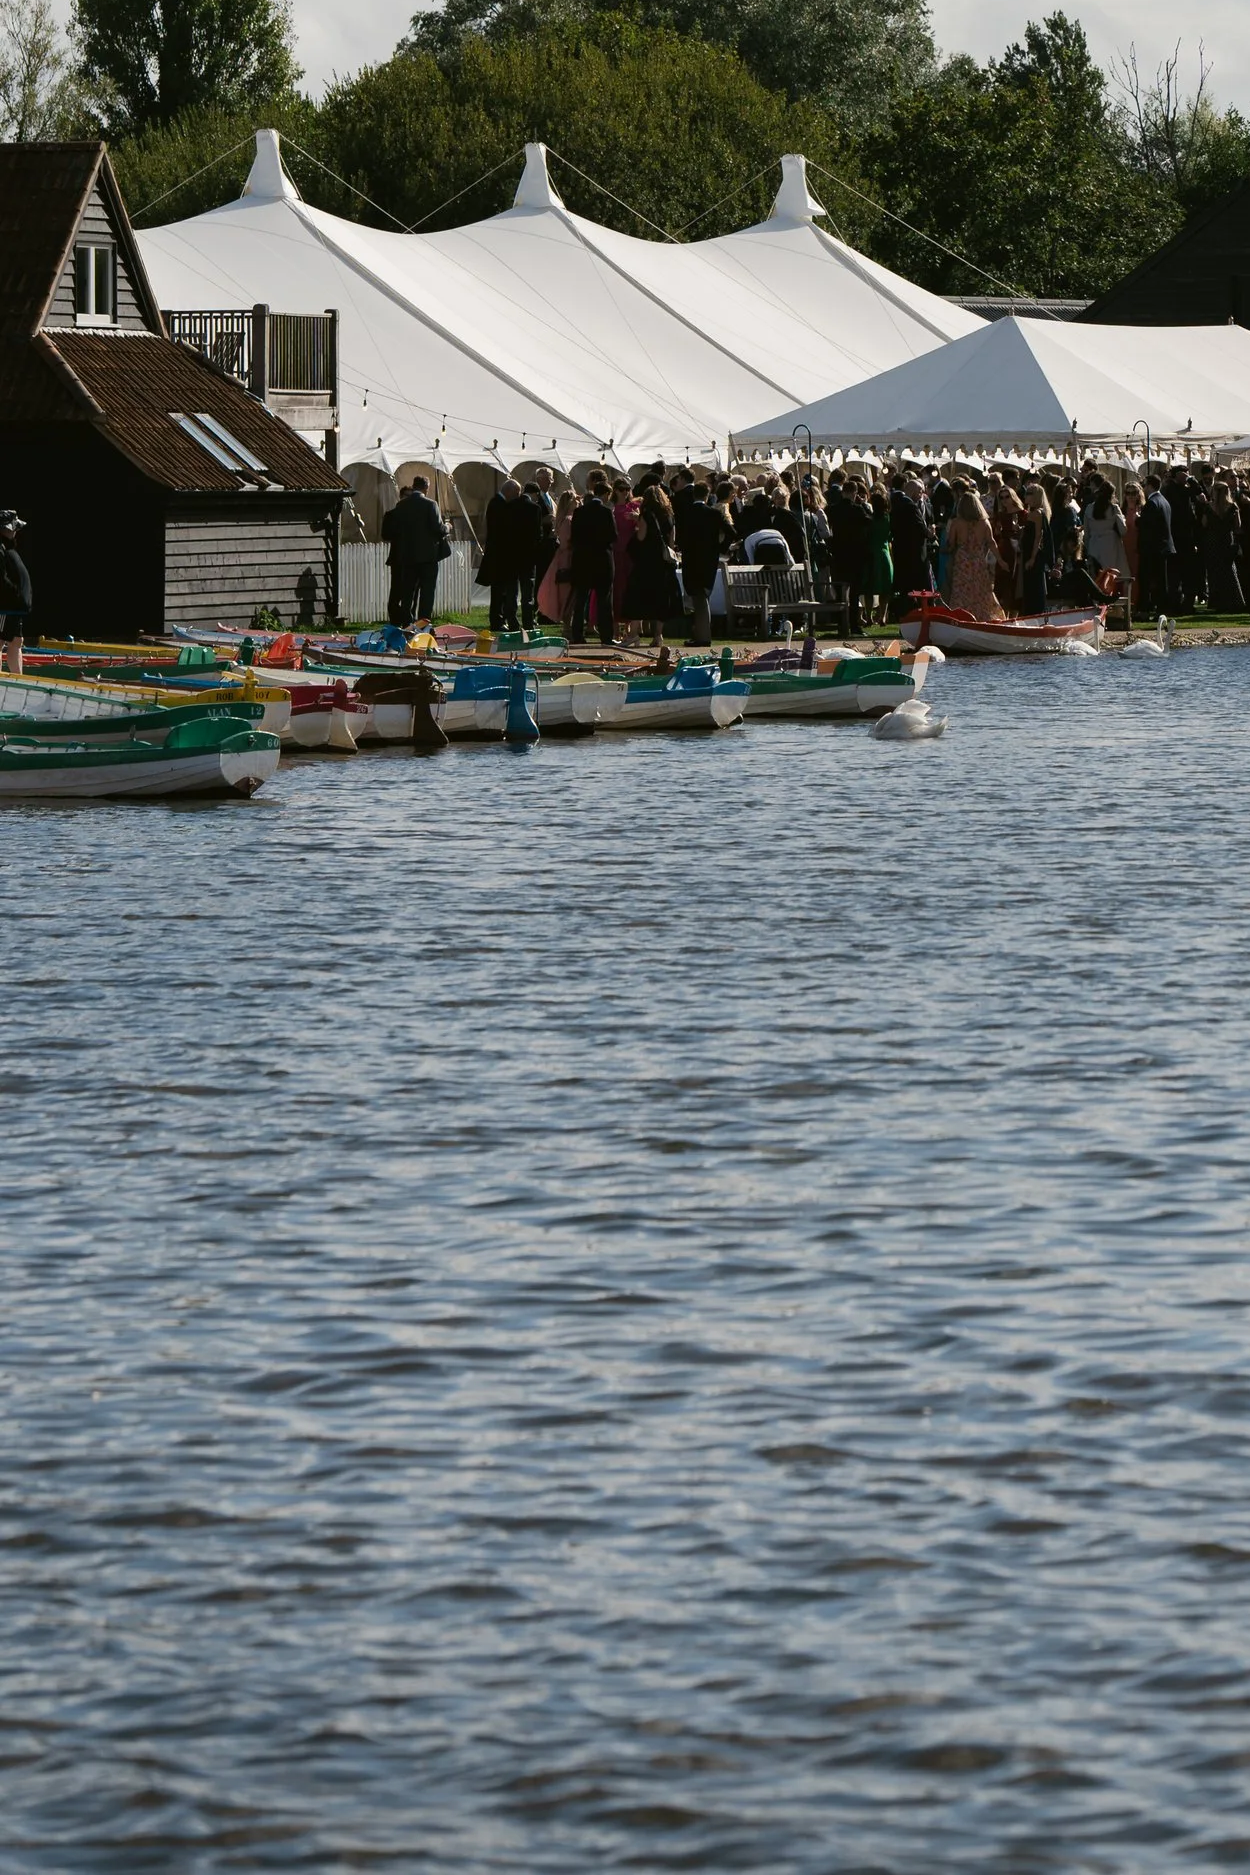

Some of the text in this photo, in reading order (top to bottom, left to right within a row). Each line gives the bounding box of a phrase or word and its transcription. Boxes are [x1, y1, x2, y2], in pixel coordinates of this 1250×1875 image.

[216, 692, 234, 702] ROB
[207, 706, 262, 717] ALAN 12
[267, 738, 279, 748] 60
